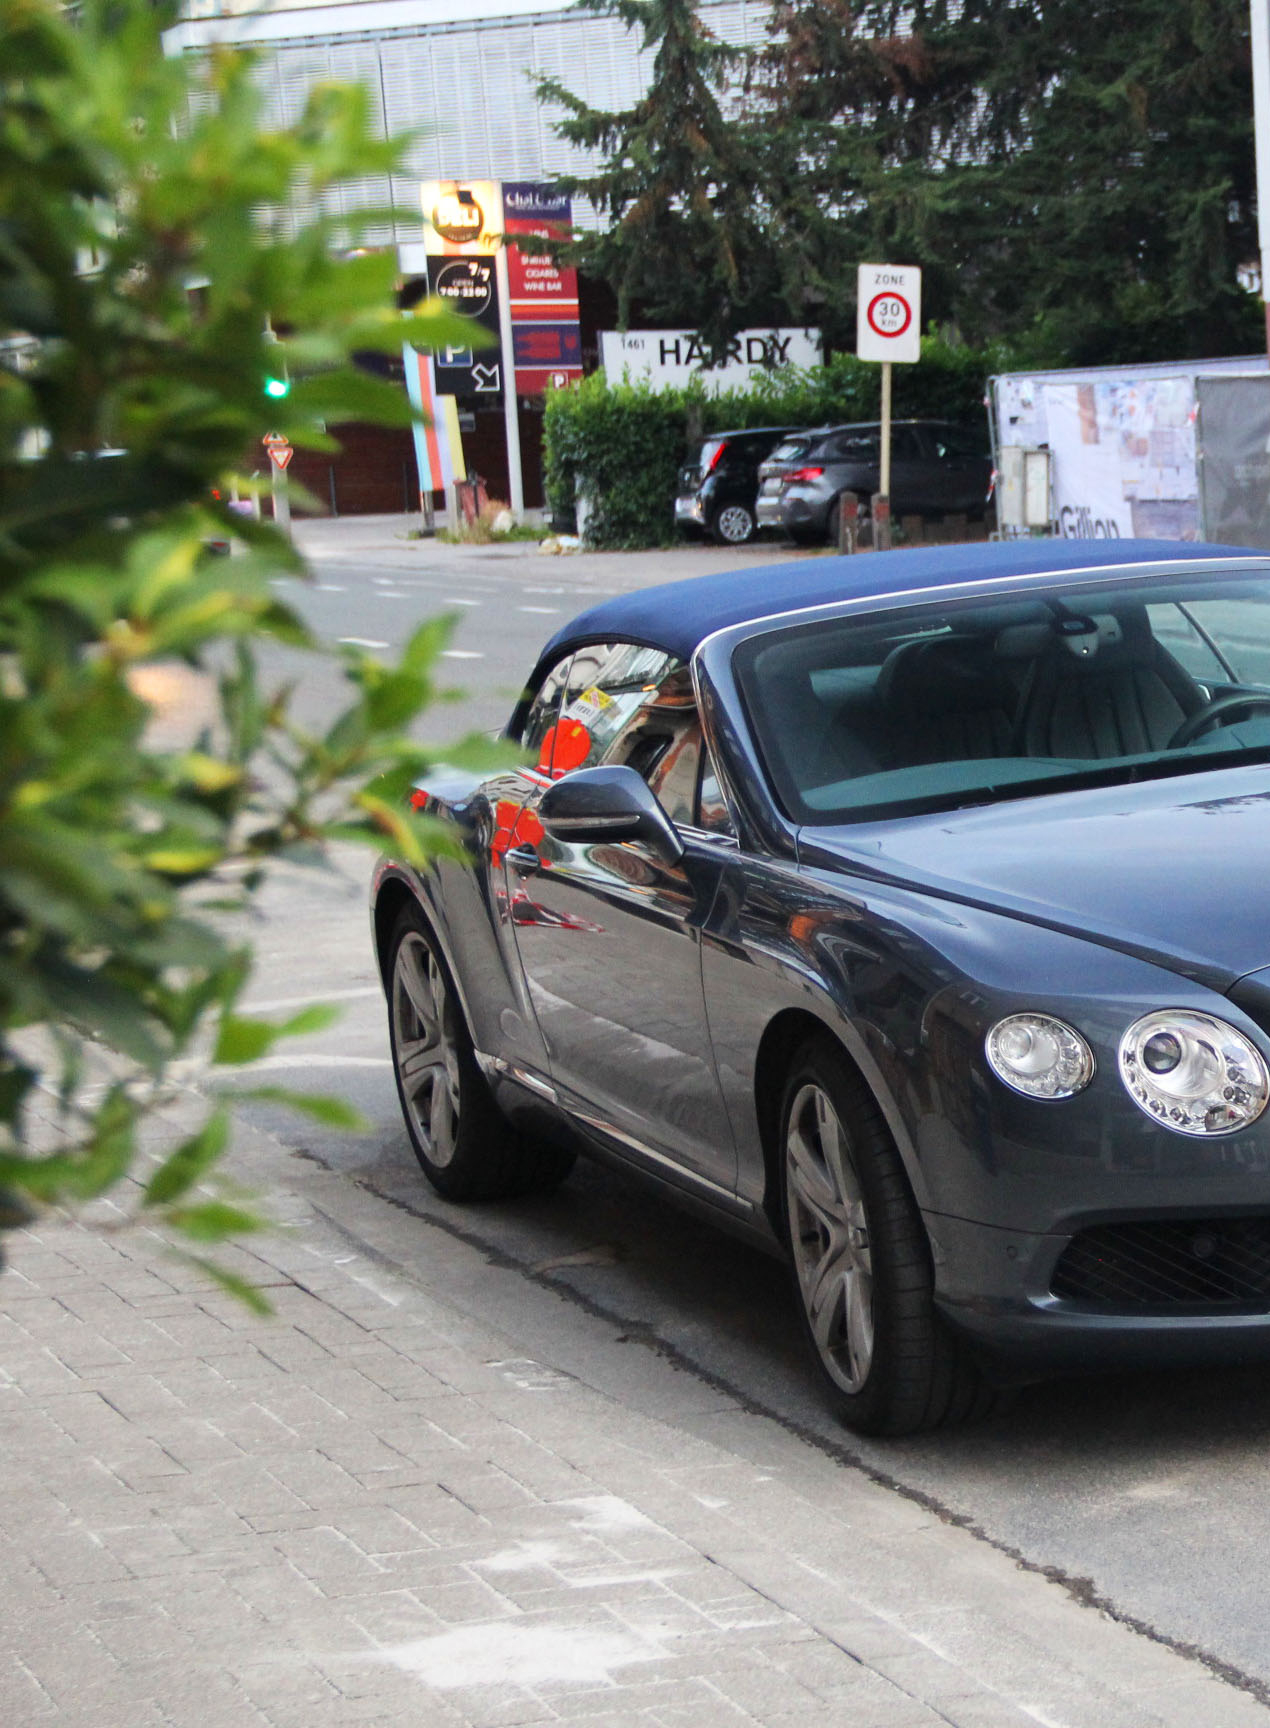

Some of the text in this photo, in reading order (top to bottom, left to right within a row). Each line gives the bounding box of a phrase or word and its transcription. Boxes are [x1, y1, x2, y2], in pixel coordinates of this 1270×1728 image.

[875, 274, 905, 286] ZONE
[880, 302, 900, 317] 30
[622, 339, 645, 350] 1461
